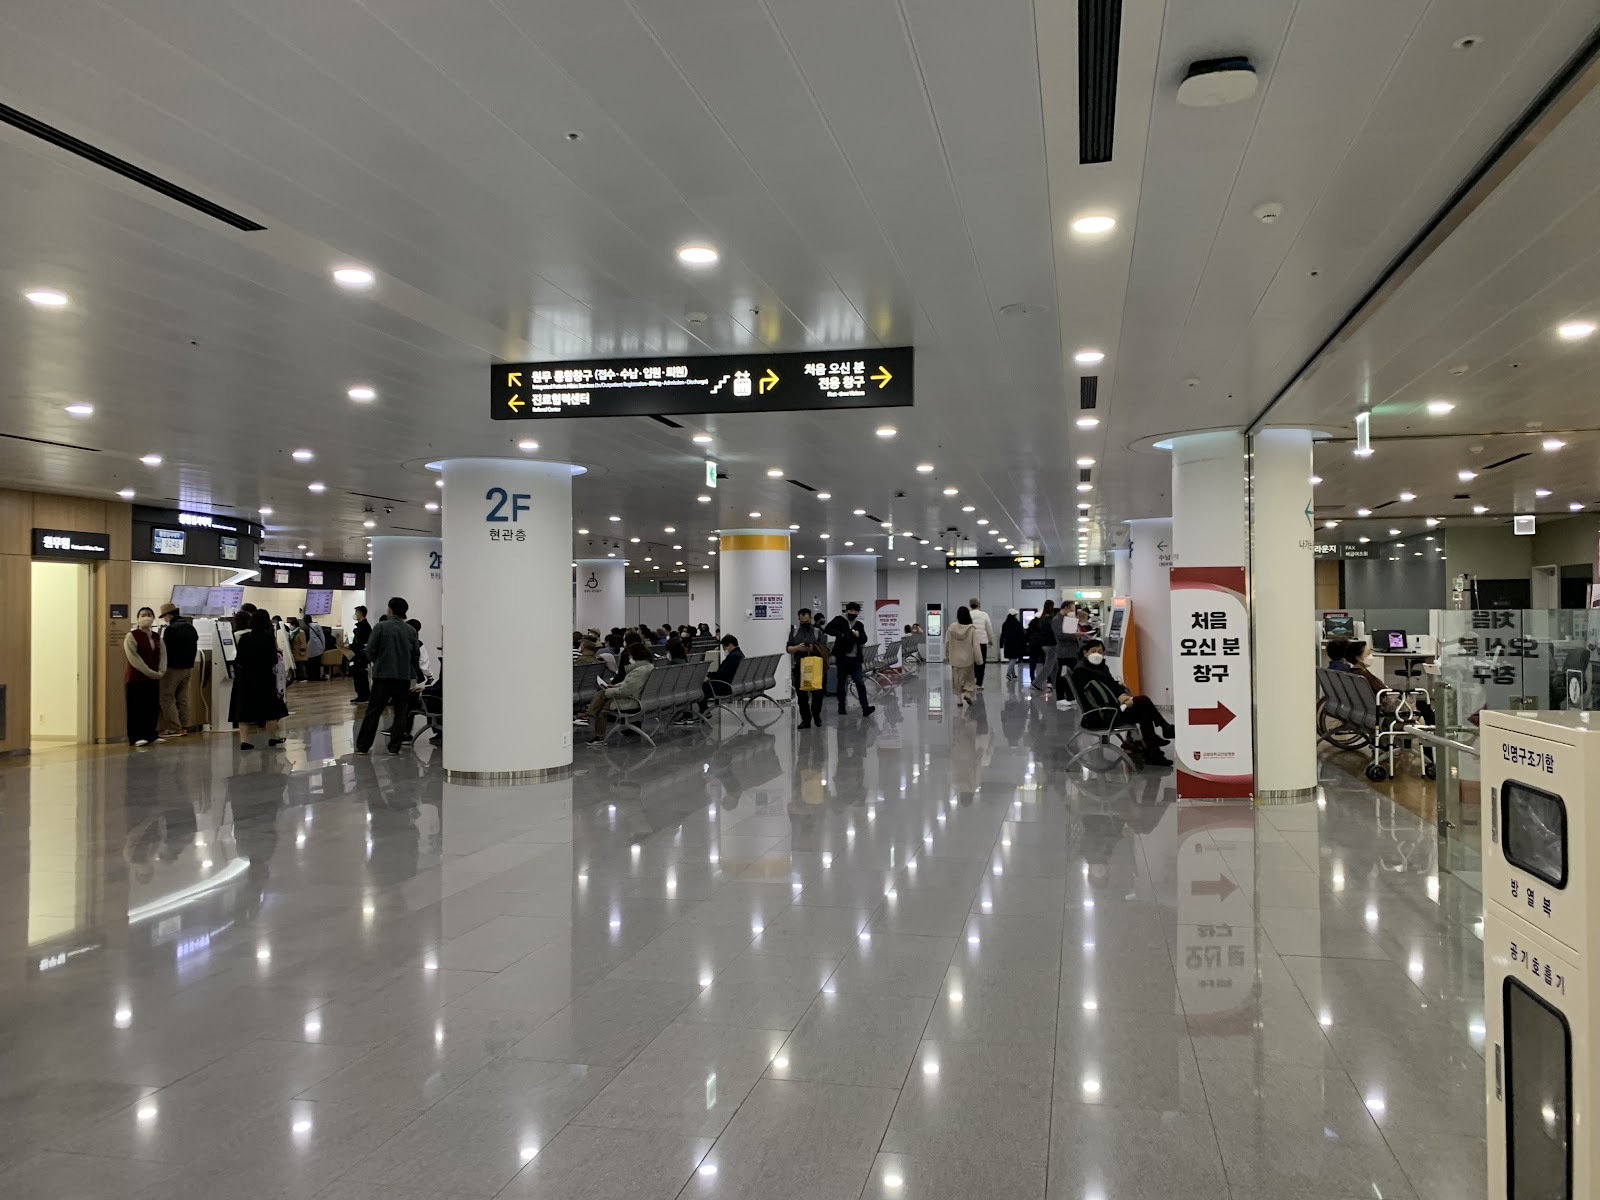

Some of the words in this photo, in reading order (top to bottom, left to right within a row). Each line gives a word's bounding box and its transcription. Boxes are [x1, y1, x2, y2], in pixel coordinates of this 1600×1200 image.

[804, 362, 826, 376] 처음
[828, 361, 851, 375] 오신
[853, 360, 865, 374] 분
[818, 375, 841, 390] 전용
[842, 374, 866, 389] 창구
[531, 391, 590, 406] 진료협력센터
[485, 486, 532, 522] 2F
[489, 528, 527, 542] 현관층
[1191, 611, 1228, 630] 처음
[1180, 638, 1217, 656] 오신
[1222, 637, 1240, 656] 분
[1193, 664, 1230, 683] 창구
[1502, 743, 1554, 774] 인명구조기함
[1510, 941, 1565, 996] 공기호흡기
